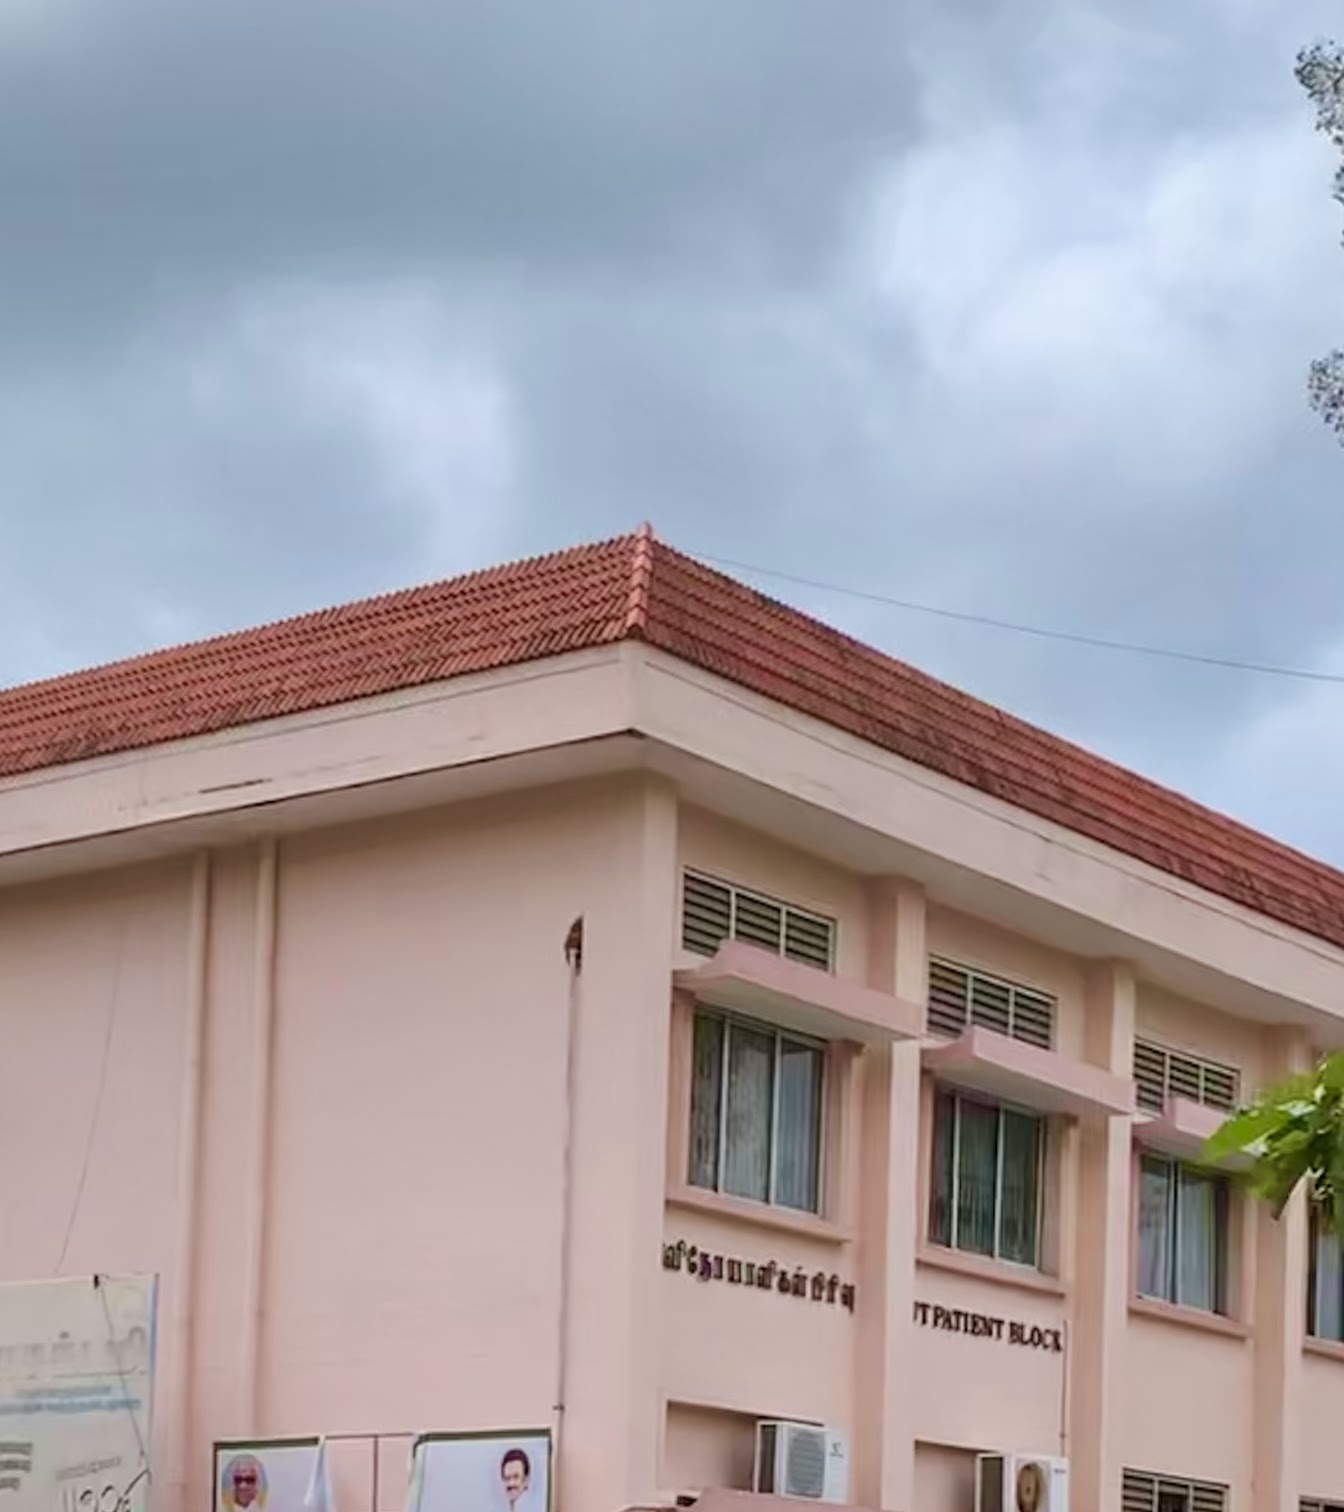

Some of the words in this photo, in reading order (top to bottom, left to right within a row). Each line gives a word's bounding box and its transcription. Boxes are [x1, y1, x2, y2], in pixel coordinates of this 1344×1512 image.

[912, 1300, 931, 1326] T
[932, 1305, 1005, 1341] PATIENT
[1007, 1320, 1063, 1353] BLOCK
